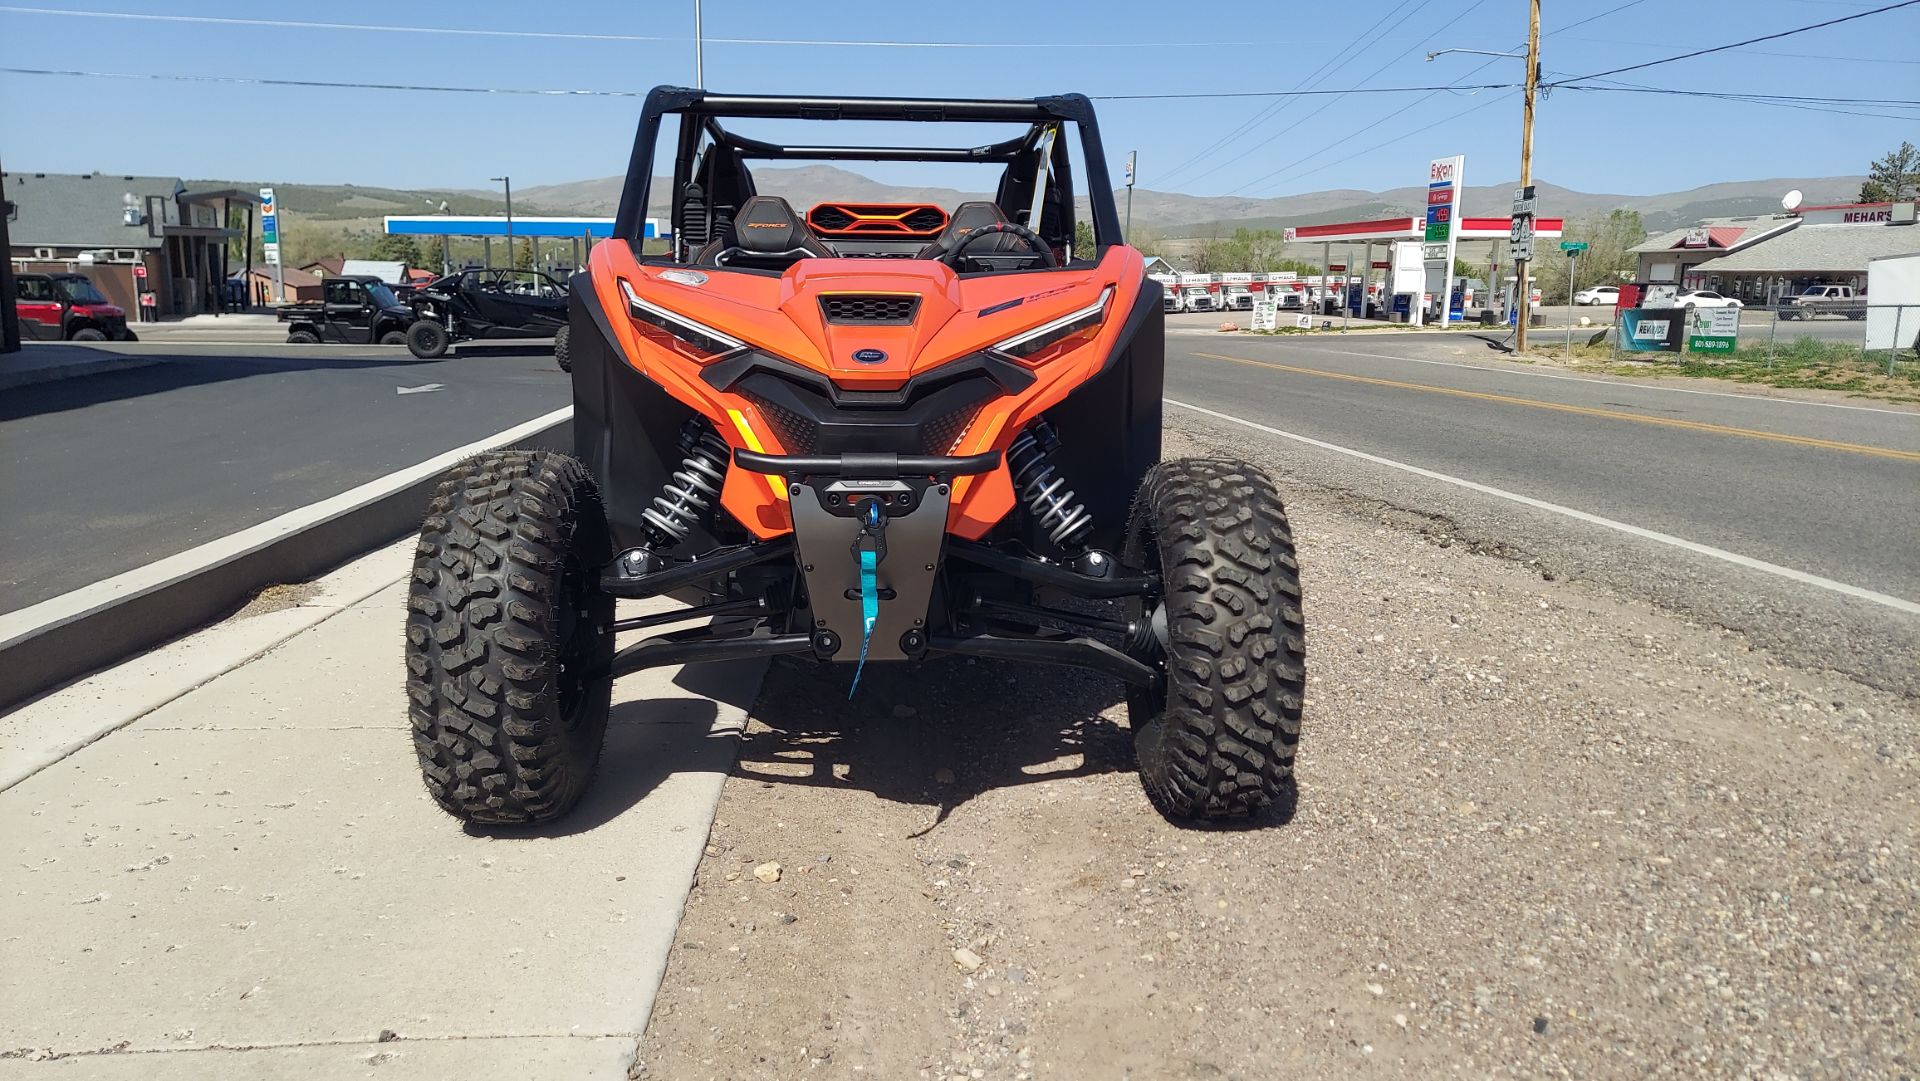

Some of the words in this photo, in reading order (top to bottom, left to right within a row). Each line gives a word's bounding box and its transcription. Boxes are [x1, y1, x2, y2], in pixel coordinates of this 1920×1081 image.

[1431, 163, 1453, 180] Exxon
[1844, 211, 1892, 223] MEHAR'S
[1512, 222, 1520, 235] 89
